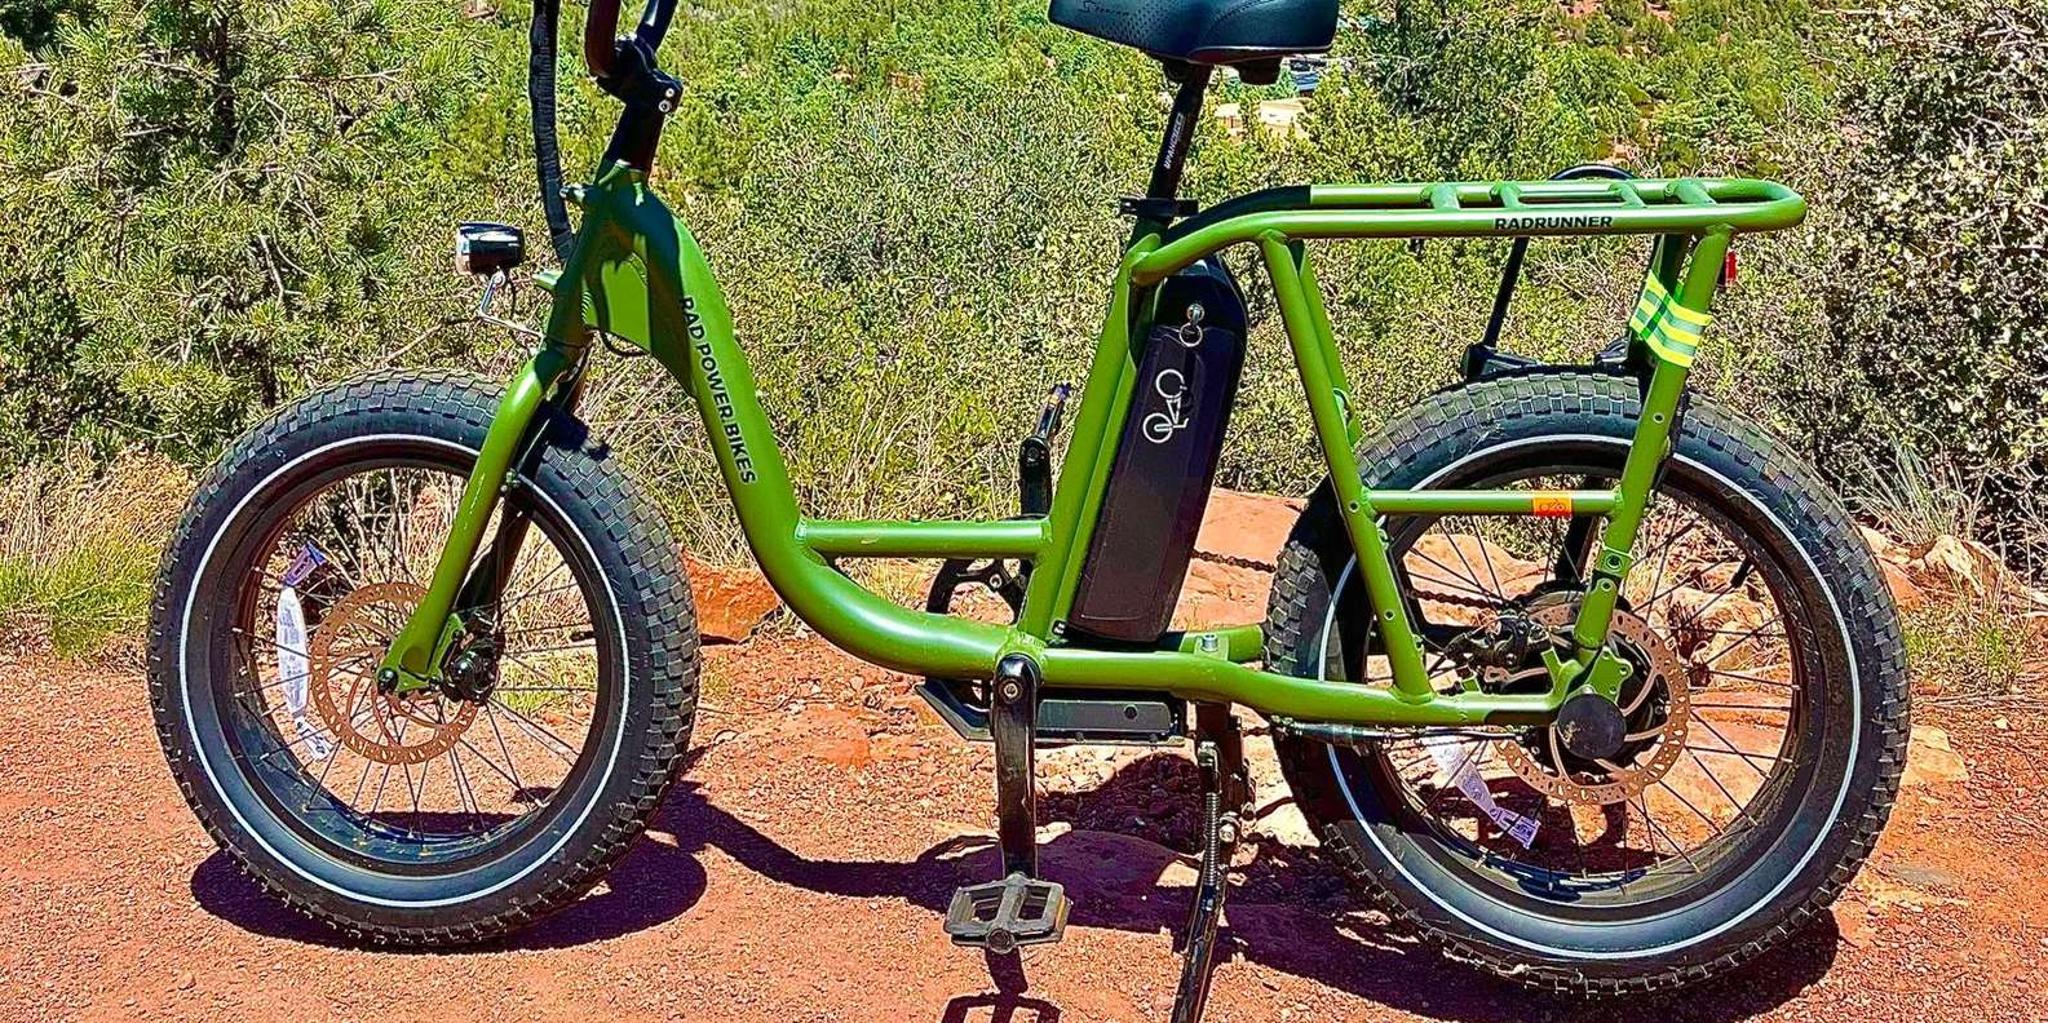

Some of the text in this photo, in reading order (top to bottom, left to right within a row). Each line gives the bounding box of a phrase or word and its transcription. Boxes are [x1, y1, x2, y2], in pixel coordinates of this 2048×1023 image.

[1494, 216, 1613, 230] RADRUNNER
[679, 296, 756, 484] RAD POWER BIKES
